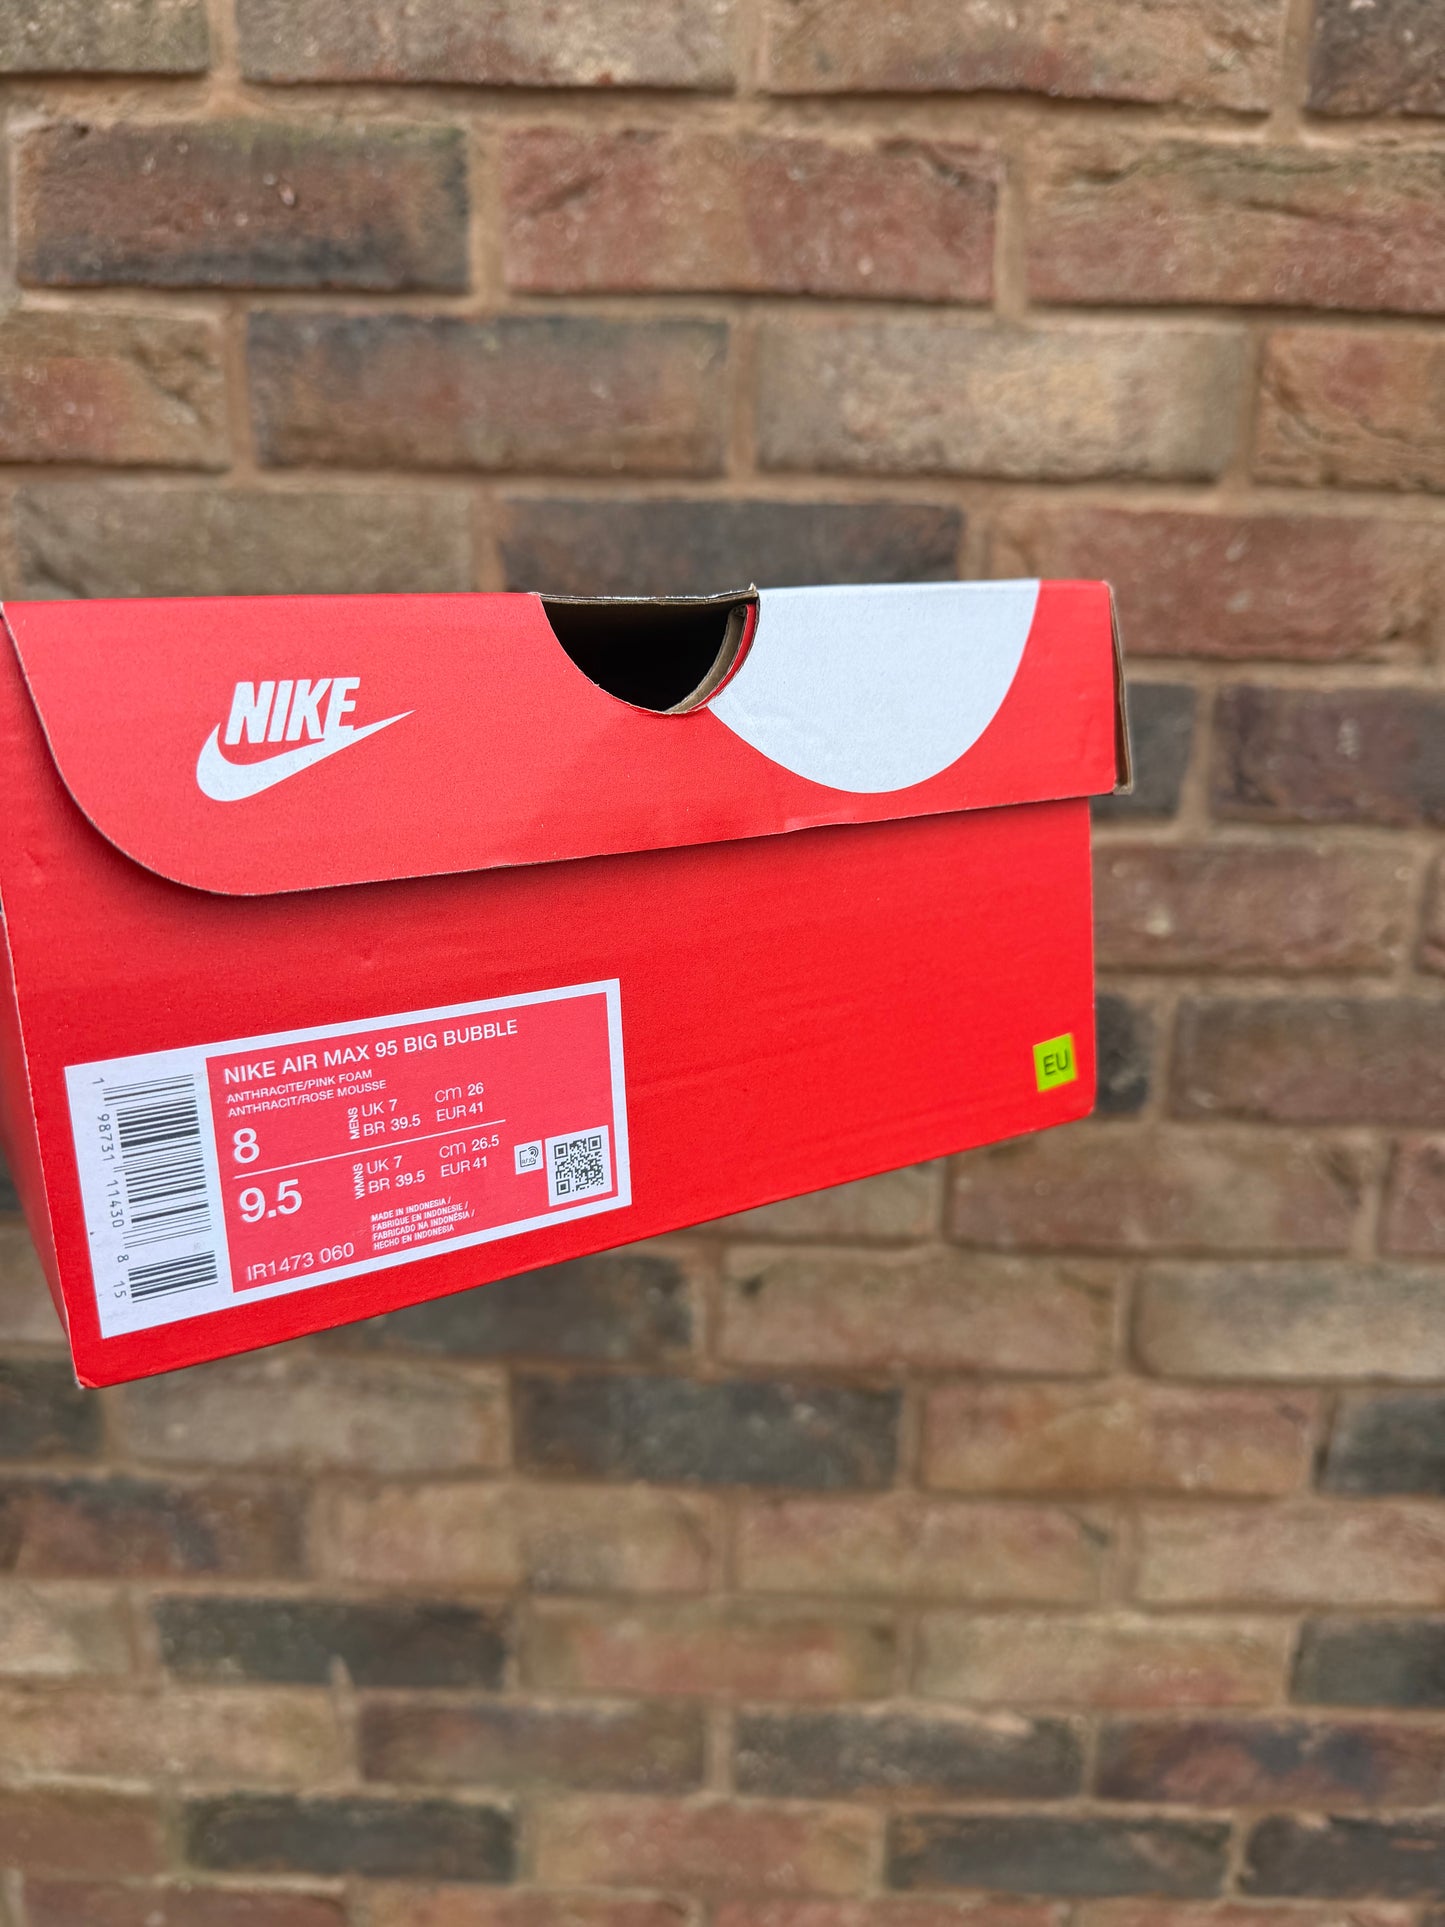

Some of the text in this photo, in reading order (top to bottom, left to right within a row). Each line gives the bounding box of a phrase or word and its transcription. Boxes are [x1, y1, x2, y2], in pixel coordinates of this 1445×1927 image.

[224, 677, 361, 745] NIKE
[224, 1019, 518, 1085] NIKE AIR MAX 95 BIG BUBBLE
[1043, 1049, 1069, 1076] EU
[226, 1069, 373, 1104] ANTHRACITE/PINK FOAM
[228, 1080, 387, 1117] ANTHRACIT/ROSE MOUSSE
[467, 1082, 484, 1097] 26
[361, 1098, 398, 1117] UK 7
[436, 1101, 484, 1122] EUR 41
[347, 1106, 360, 1140] MENS
[363, 1113, 421, 1137] BR 39.5
[233, 1127, 260, 1164] 8
[471, 1134, 500, 1151] 26.5
[366, 1155, 403, 1174] UK 7
[441, 1156, 488, 1177] EUR 41
[92, 1077, 129, 1299] 1 98731 11430 8 15
[352, 1162, 366, 1200] WMNS
[368, 1170, 426, 1194] BR 39.5
[239, 1178, 303, 1223] 9.5
[371, 1211, 394, 1222] MADE
[395, 1207, 404, 1216] IN
[406, 1198, 446, 1214] INDONESIA
[372, 1216, 410, 1231] FABRIQUE
[412, 1213, 422, 1222] EN
[424, 1203, 463, 1218] INDONESIE
[372, 1225, 416, 1241] FABRICADO
[418, 1221, 429, 1230] NA
[373, 1224, 454, 1251] HECHO EN INDONESIA
[246, 1242, 355, 1281] IR1473 060
